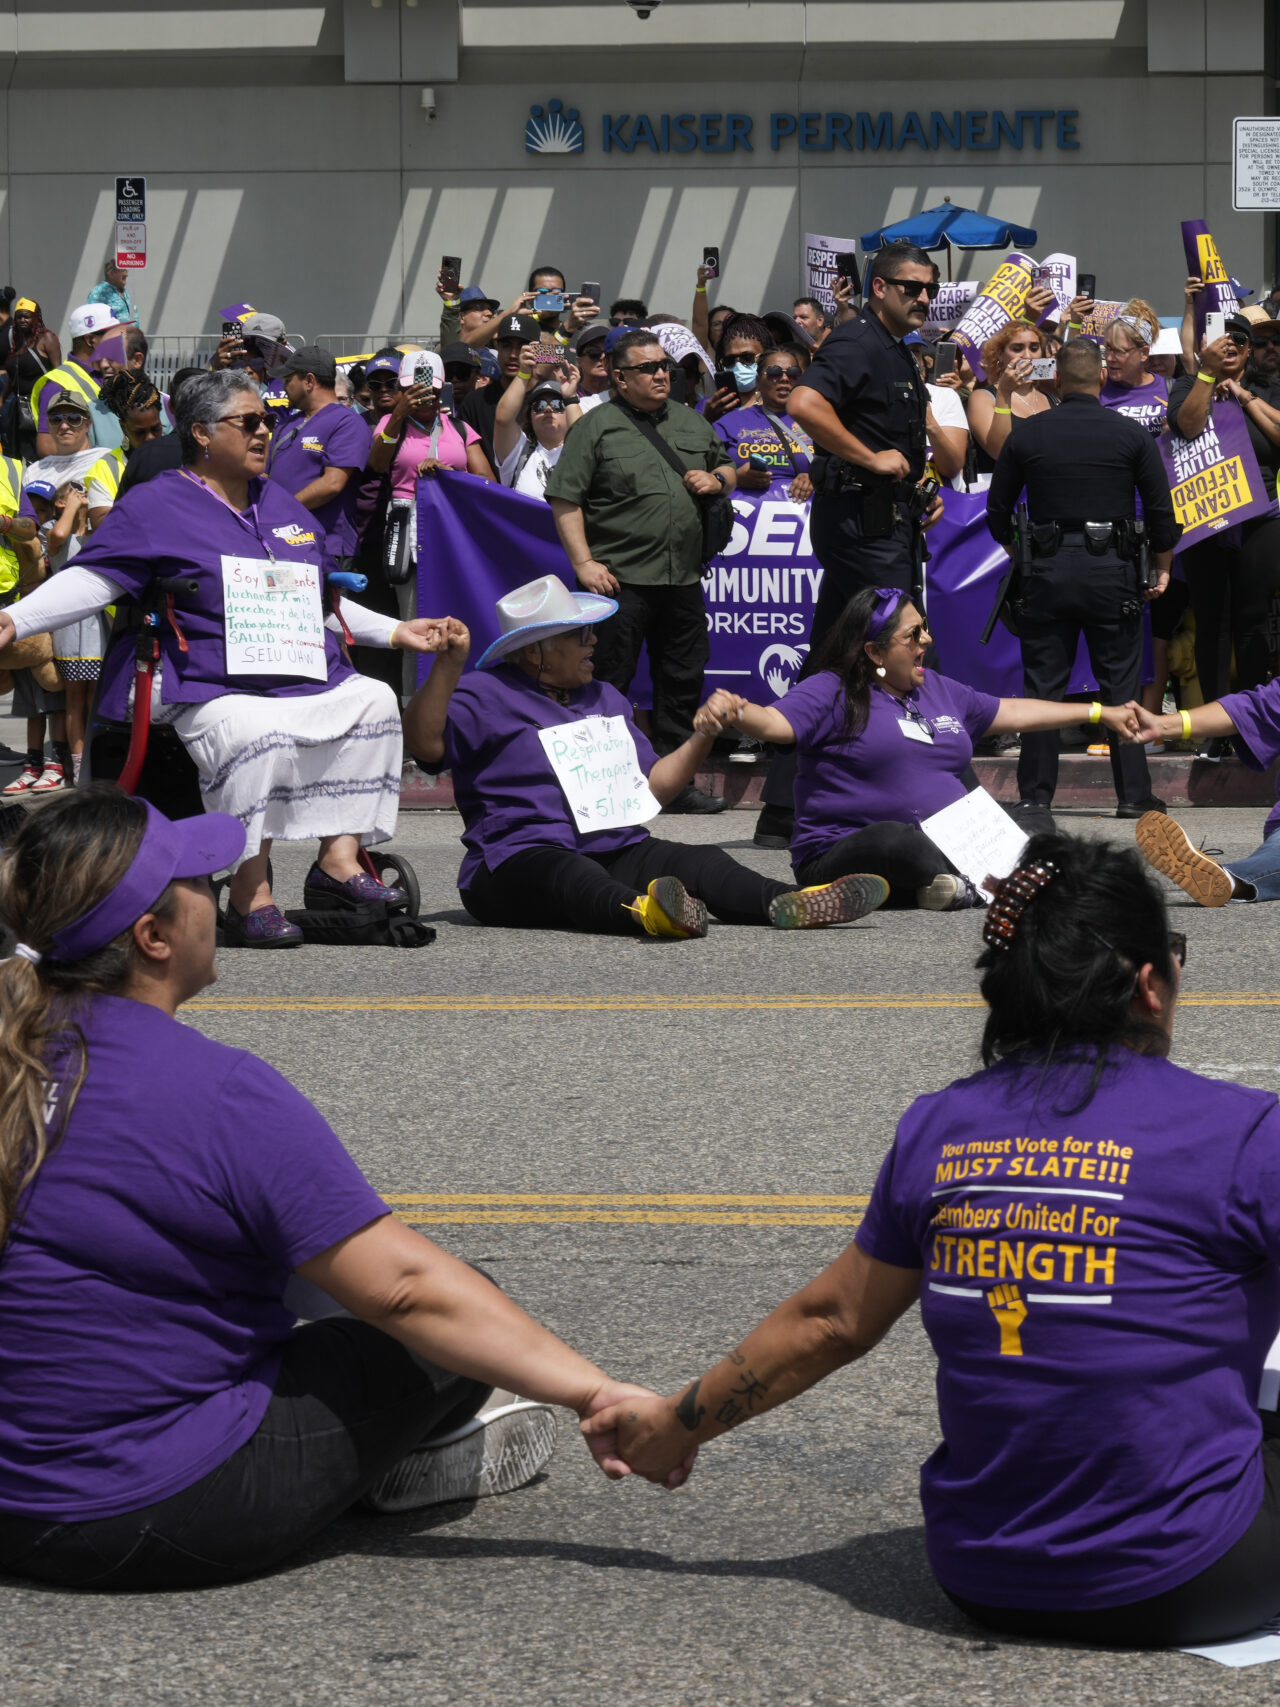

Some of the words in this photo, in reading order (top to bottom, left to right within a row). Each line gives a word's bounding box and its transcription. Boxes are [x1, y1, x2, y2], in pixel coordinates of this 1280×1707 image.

[602, 113, 754, 153] KAISER
[771, 109, 1081, 152] PERMANENTE
[808, 249, 838, 268] RESPEC
[510, 317, 520, 331] LA
[1117, 405, 1161, 418] SEIU
[1205, 445, 1225, 466] TO
[1174, 455, 1204, 483] LIVE
[1173, 460, 1239, 508] AFFORD
[1233, 484, 1242, 504] I
[1181, 489, 1231, 528] CAN'T
[232, 568, 259, 591] Soy
[700, 567, 825, 604] MMUNITY
[226, 584, 278, 602] luchando
[226, 603, 276, 615] derechos
[279, 609, 285, 618] y
[288, 607, 300, 618] de
[302, 609, 316, 621] los
[228, 630, 275, 645] SALUD
[298, 622, 309, 633] de
[313, 625, 321, 634] la
[241, 646, 282, 663] SEIU
[288, 650, 315, 665] UHW
[552, 738, 631, 764] Respiratory
[568, 762, 632, 790] Therapist
[596, 797, 615, 818] 51
[941, 1143, 965, 1158] You
[966, 1138, 1012, 1154] must
[1015, 1137, 1058, 1153] Vote
[1063, 1136, 1093, 1153] for
[1097, 1140, 1134, 1159] the
[935, 1157, 1003, 1184] MUST
[1006, 1156, 1130, 1185] SLATE!!!
[1005, 1202, 1077, 1233] United
[1080, 1206, 1120, 1237] For
[930, 1234, 1116, 1285] STRENGTH
